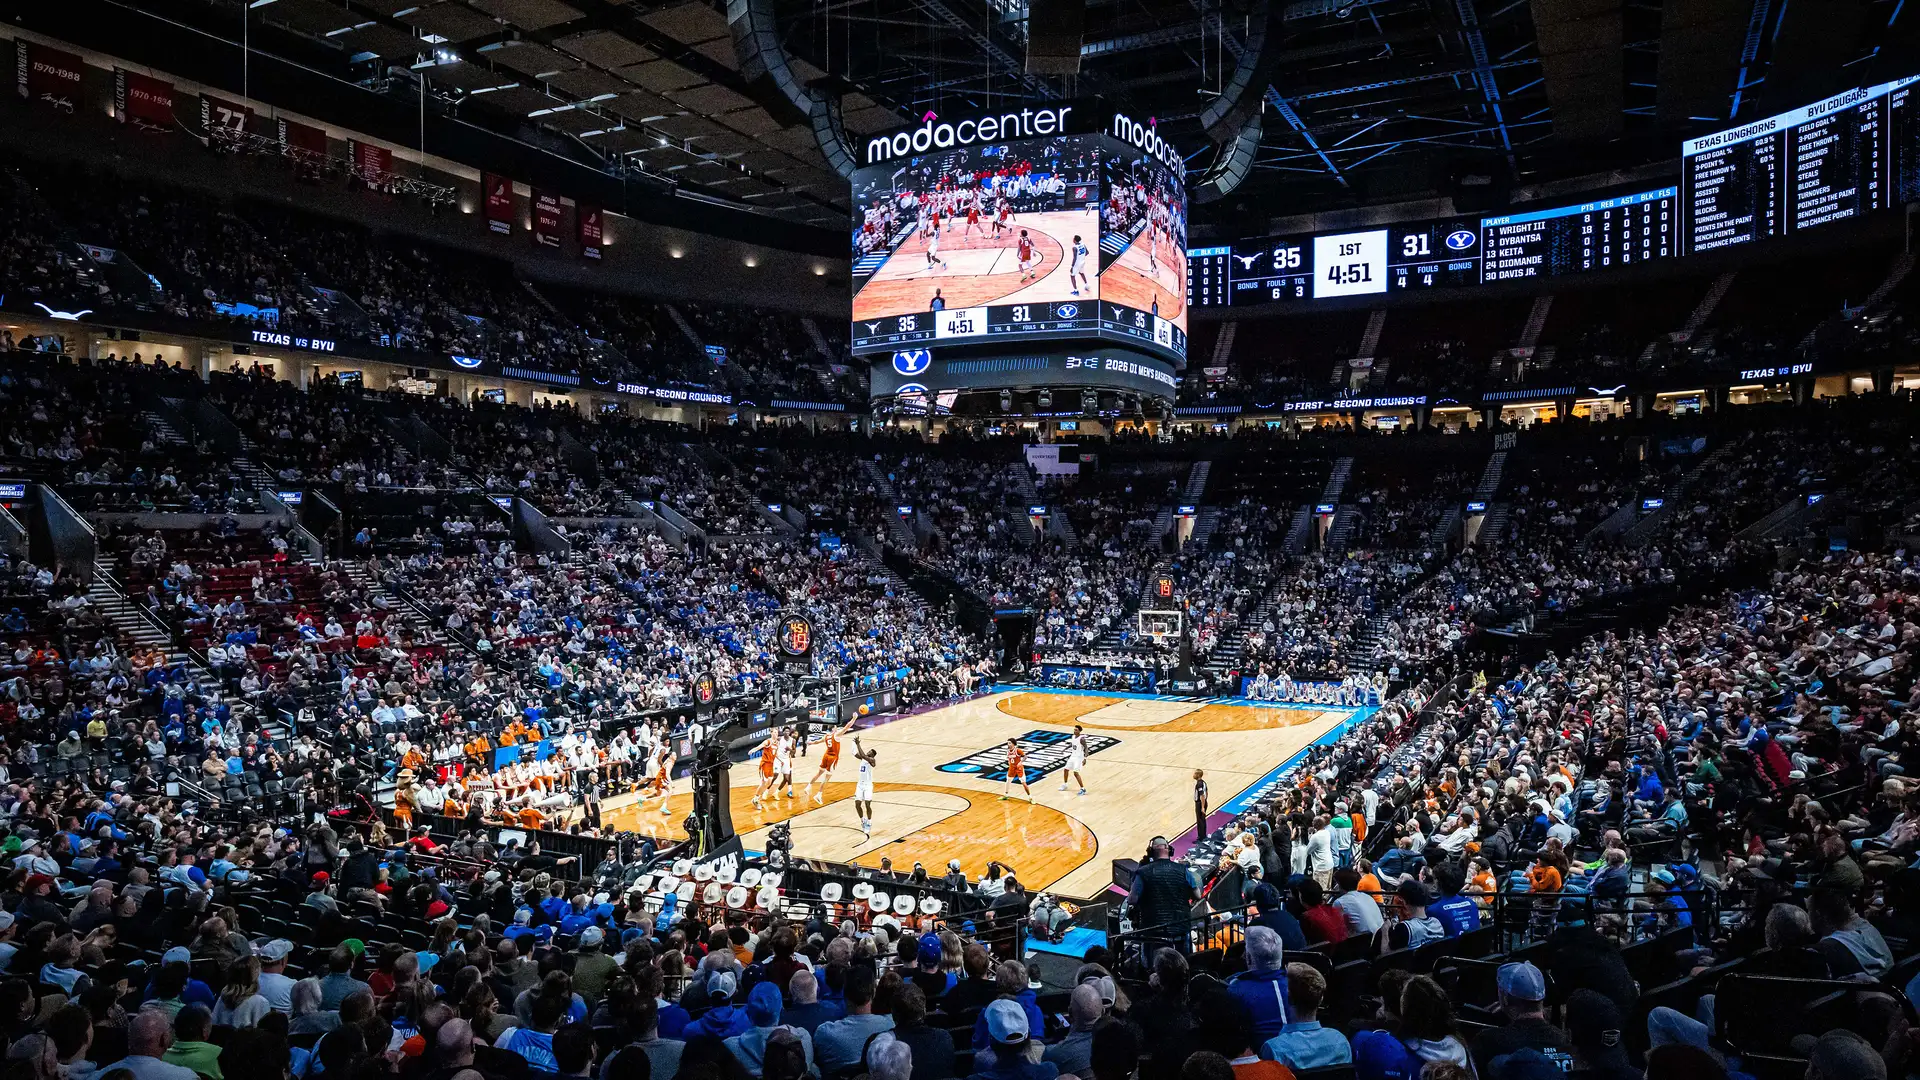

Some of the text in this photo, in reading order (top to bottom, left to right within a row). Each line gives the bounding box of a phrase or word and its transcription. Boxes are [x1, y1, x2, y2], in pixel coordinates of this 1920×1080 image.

[17, 42, 28, 85] WEINBERG
[33, 62, 80, 82] 1970-1988
[1808, 88, 1868, 117] BYU COUGARS
[1799, 122, 1814, 133] FIELD
[1816, 117, 1829, 128] GOAL
[1694, 120, 1775, 150] TEXAS LONGHORNS
[1798, 129, 1821, 143] 3-POINT
[1799, 123, 1872, 152] FREE THROW 100
[1696, 152, 1711, 162] FIELD
[1712, 149, 1726, 158] GOAL
[1798, 147, 1828, 162] REBOUNDS
[1695, 159, 1718, 171] 3-POINT
[1798, 158, 1822, 171] ASSISTS
[1695, 171, 1708, 180] FREE
[1710, 166, 1729, 176] THROW
[1798, 169, 1818, 181] STEALS
[1695, 176, 1724, 189] REBOUNDS
[1798, 178, 1819, 190] BLOCKS
[1695, 186, 1719, 198] ASSISTS
[1798, 185, 1830, 200] TURNOVERS
[1798, 198, 1818, 210] POINTS
[1820, 195, 1826, 204] IN
[1827, 192, 1837, 202] THE
[1839, 187, 1856, 198] PAINT
[1486, 217, 1510, 226] PLAYER
[1581, 204, 1594, 212] PTS
[1620, 197, 1633, 205] AST
[1640, 193, 1654, 201] BLK
[1658, 189, 1670, 198] FLS
[1695, 196, 1715, 206] STEALS
[1695, 205, 1716, 216] BLOCKS
[1798, 202, 1838, 219] BENCH POINTS
[1500, 223, 1532, 235] WRIGHT
[1533, 222, 1546, 230] III
[1584, 214, 1590, 222] 8
[1624, 208, 1629, 216] 1
[1695, 212, 1727, 224] TURNOVERS
[1695, 223, 1715, 234] POINTS
[1724, 219, 1734, 227] THE
[1736, 215, 1752, 224] PAINT
[1798, 208, 1853, 229] 2ND CHANCE POINTS
[1500, 233, 1541, 246] DYBANTSA
[1624, 219, 1629, 227] 0
[1695, 228, 1734, 242] BENCH POINTS
[1403, 234, 1430, 256] 31
[1486, 250, 1496, 258] 13
[1500, 247, 1523, 257] KEITA
[1624, 231, 1629, 239] 0
[1695, 234, 1750, 251] 2ND CHANCE POINTS
[1339, 243, 1361, 257] 1ST
[1273, 247, 1301, 269] 35
[1486, 261, 1496, 269] 24
[1499, 255, 1542, 268] DIOMANDE
[1328, 262, 1372, 284] 4:51
[1417, 265, 1438, 274] FOULS
[1449, 261, 1472, 271] BONUS
[1486, 272, 1496, 280] 30
[1499, 269, 1524, 279] DAVIS
[1525, 267, 1536, 276] JR.
[1624, 254, 1629, 262] 0
[1238, 282, 1258, 290] BONUS
[1267, 279, 1286, 288] FOULS
[1294, 277, 1305, 285] TOL
[1398, 277, 1406, 288] 4
[1423, 274, 1432, 286] 4
[1273, 288, 1280, 299] 6
[1296, 286, 1303, 297] 3
[1012, 306, 1031, 321] 31
[1135, 312, 1145, 328] 35
[899, 316, 915, 331] 35
[948, 320, 974, 334] 4:51
[252, 331, 334, 352] TEXAS VS BYU
[1105, 359, 1154, 378] 2026 DI MEN'S
[1741, 368, 1774, 379] TEXAS
[1792, 363, 1812, 374] BYU
[626, 385, 722, 403] FIRST SECOND ROUNDS
[1295, 397, 1415, 410] FIRST SECOND ROUNDS
[1495, 432, 1516, 443] BLOCK
[1495, 440, 1516, 450] PARTY
[1160, 585, 1169, 596] 19
[793, 633, 806, 651] 19
[702, 688, 710, 700] 19
[517, 1046, 552, 1064] WATSON
